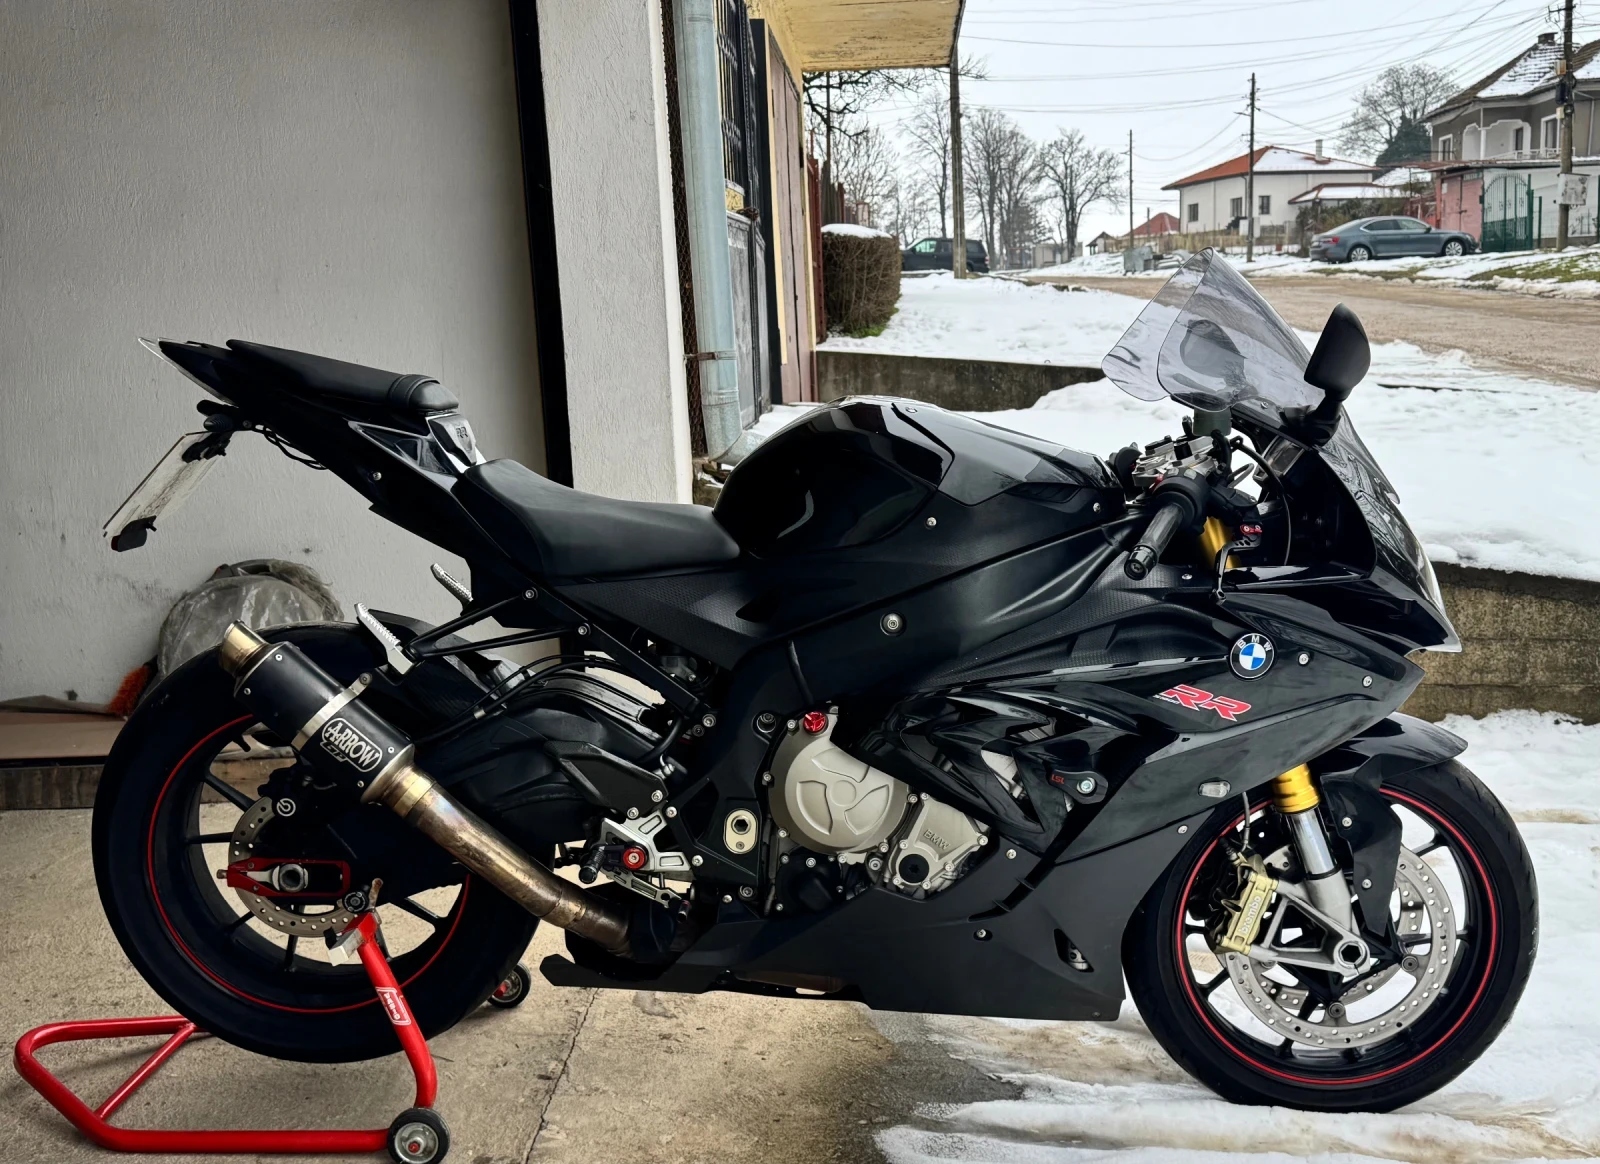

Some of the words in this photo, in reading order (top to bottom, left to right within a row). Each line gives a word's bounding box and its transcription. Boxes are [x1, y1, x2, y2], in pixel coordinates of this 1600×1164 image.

[1159, 684, 1252, 722] RR
[324, 721, 381, 767] ARROW
[922, 829, 950, 850] BMW
[1239, 895, 1262, 935] brembo
